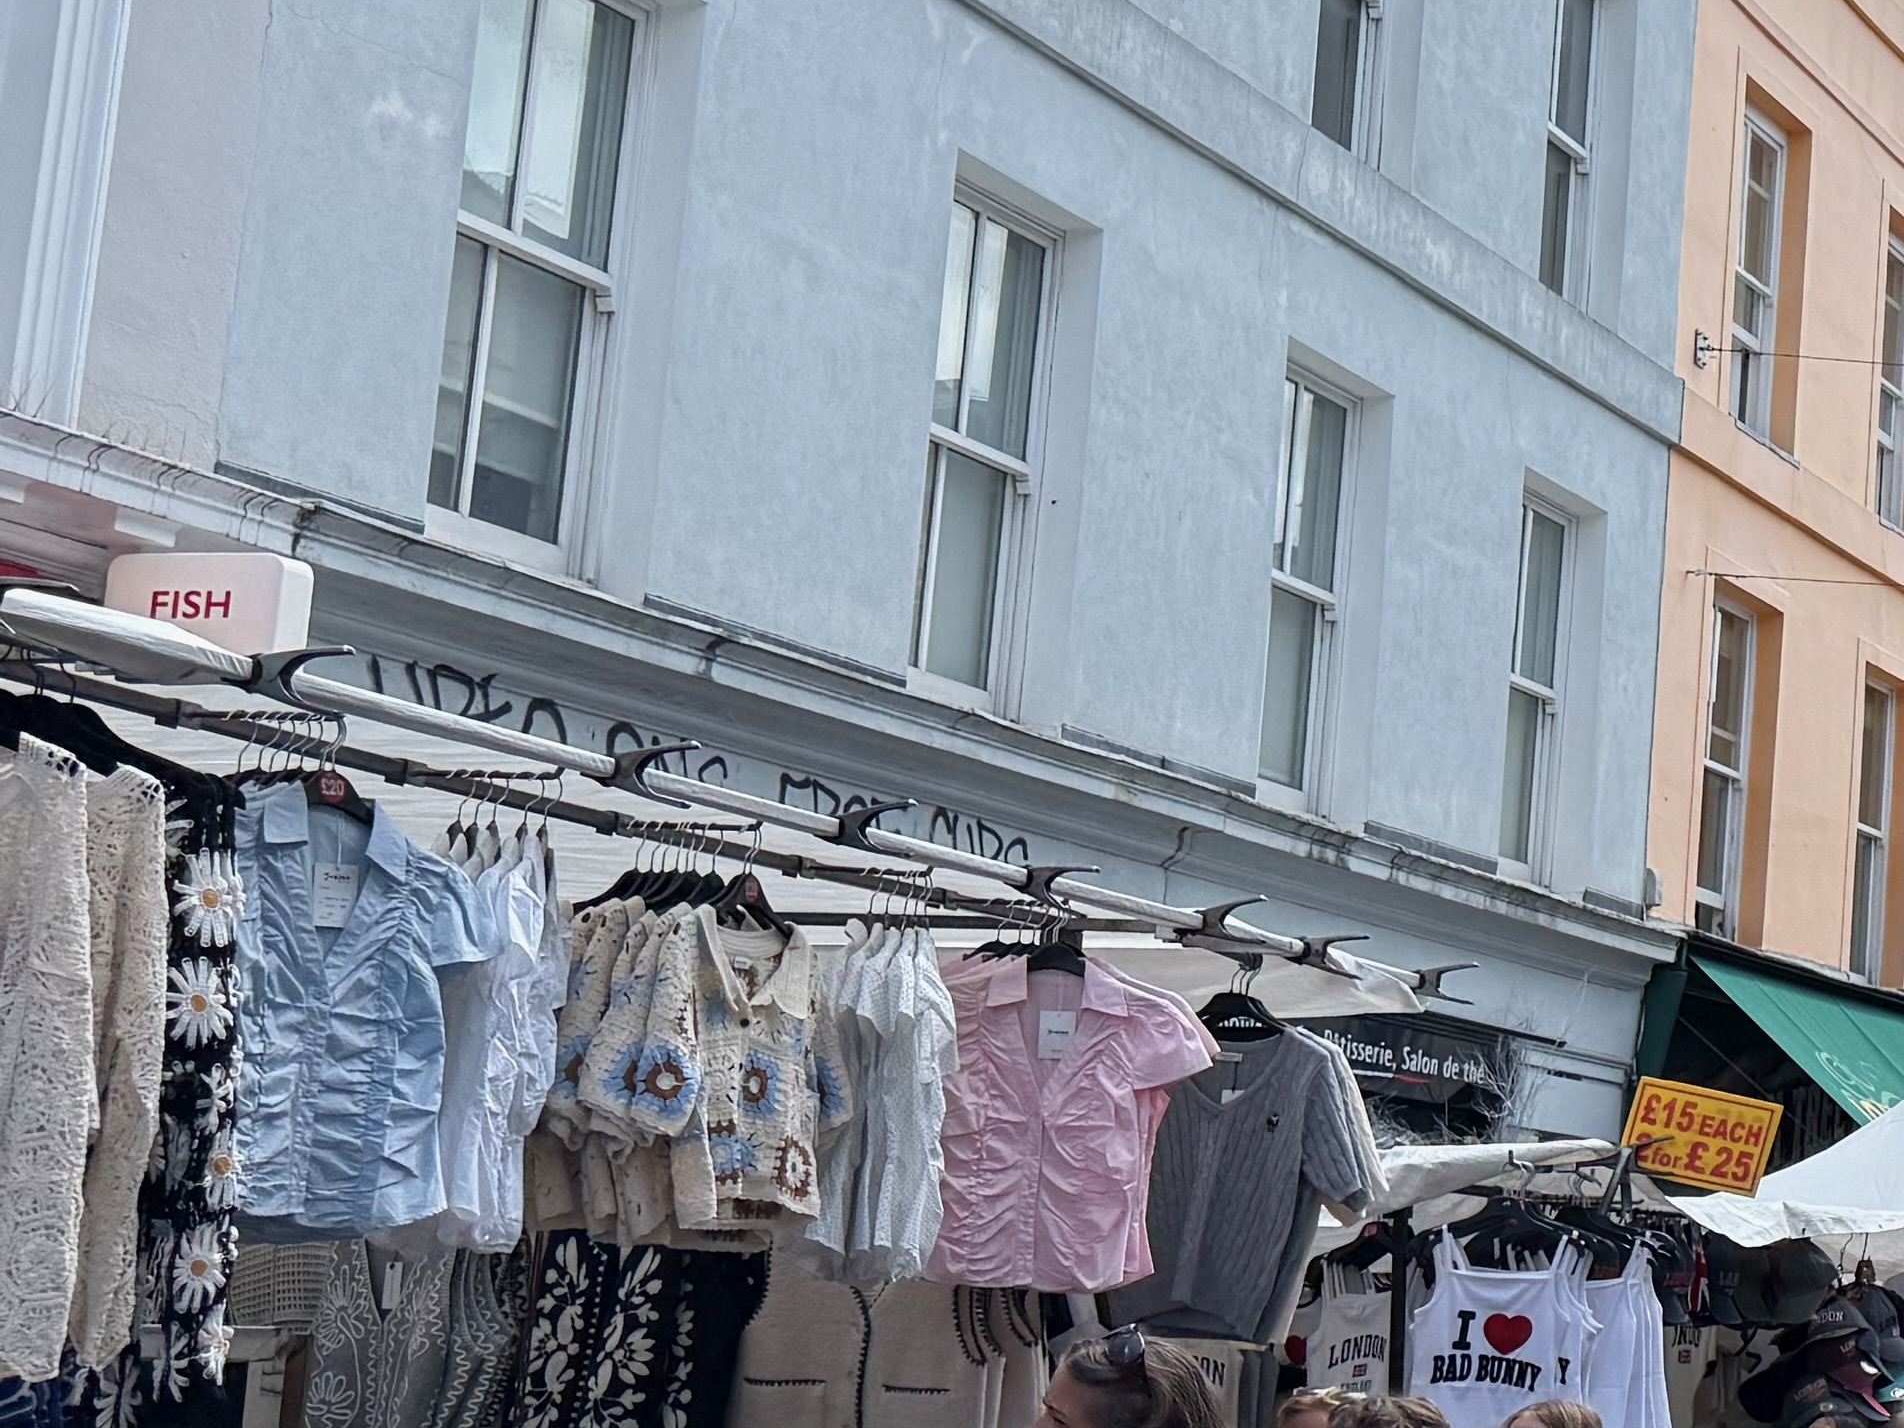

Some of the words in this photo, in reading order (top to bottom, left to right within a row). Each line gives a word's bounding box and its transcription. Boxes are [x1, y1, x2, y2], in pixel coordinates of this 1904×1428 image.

[150, 590, 232, 620] FISH
[1401, 1046, 1439, 1076] Salon
[1443, 1056, 1460, 1080] de
[1640, 1093, 1698, 1133] £15
[1700, 1114, 1762, 1148] EACH
[1652, 1146, 1683, 1169] for
[1452, 1310, 1477, 1351] I
[1328, 1334, 1387, 1369] LONDON
[1430, 1353, 1473, 1384] BAD
[1475, 1353, 1543, 1392] BUNNY
